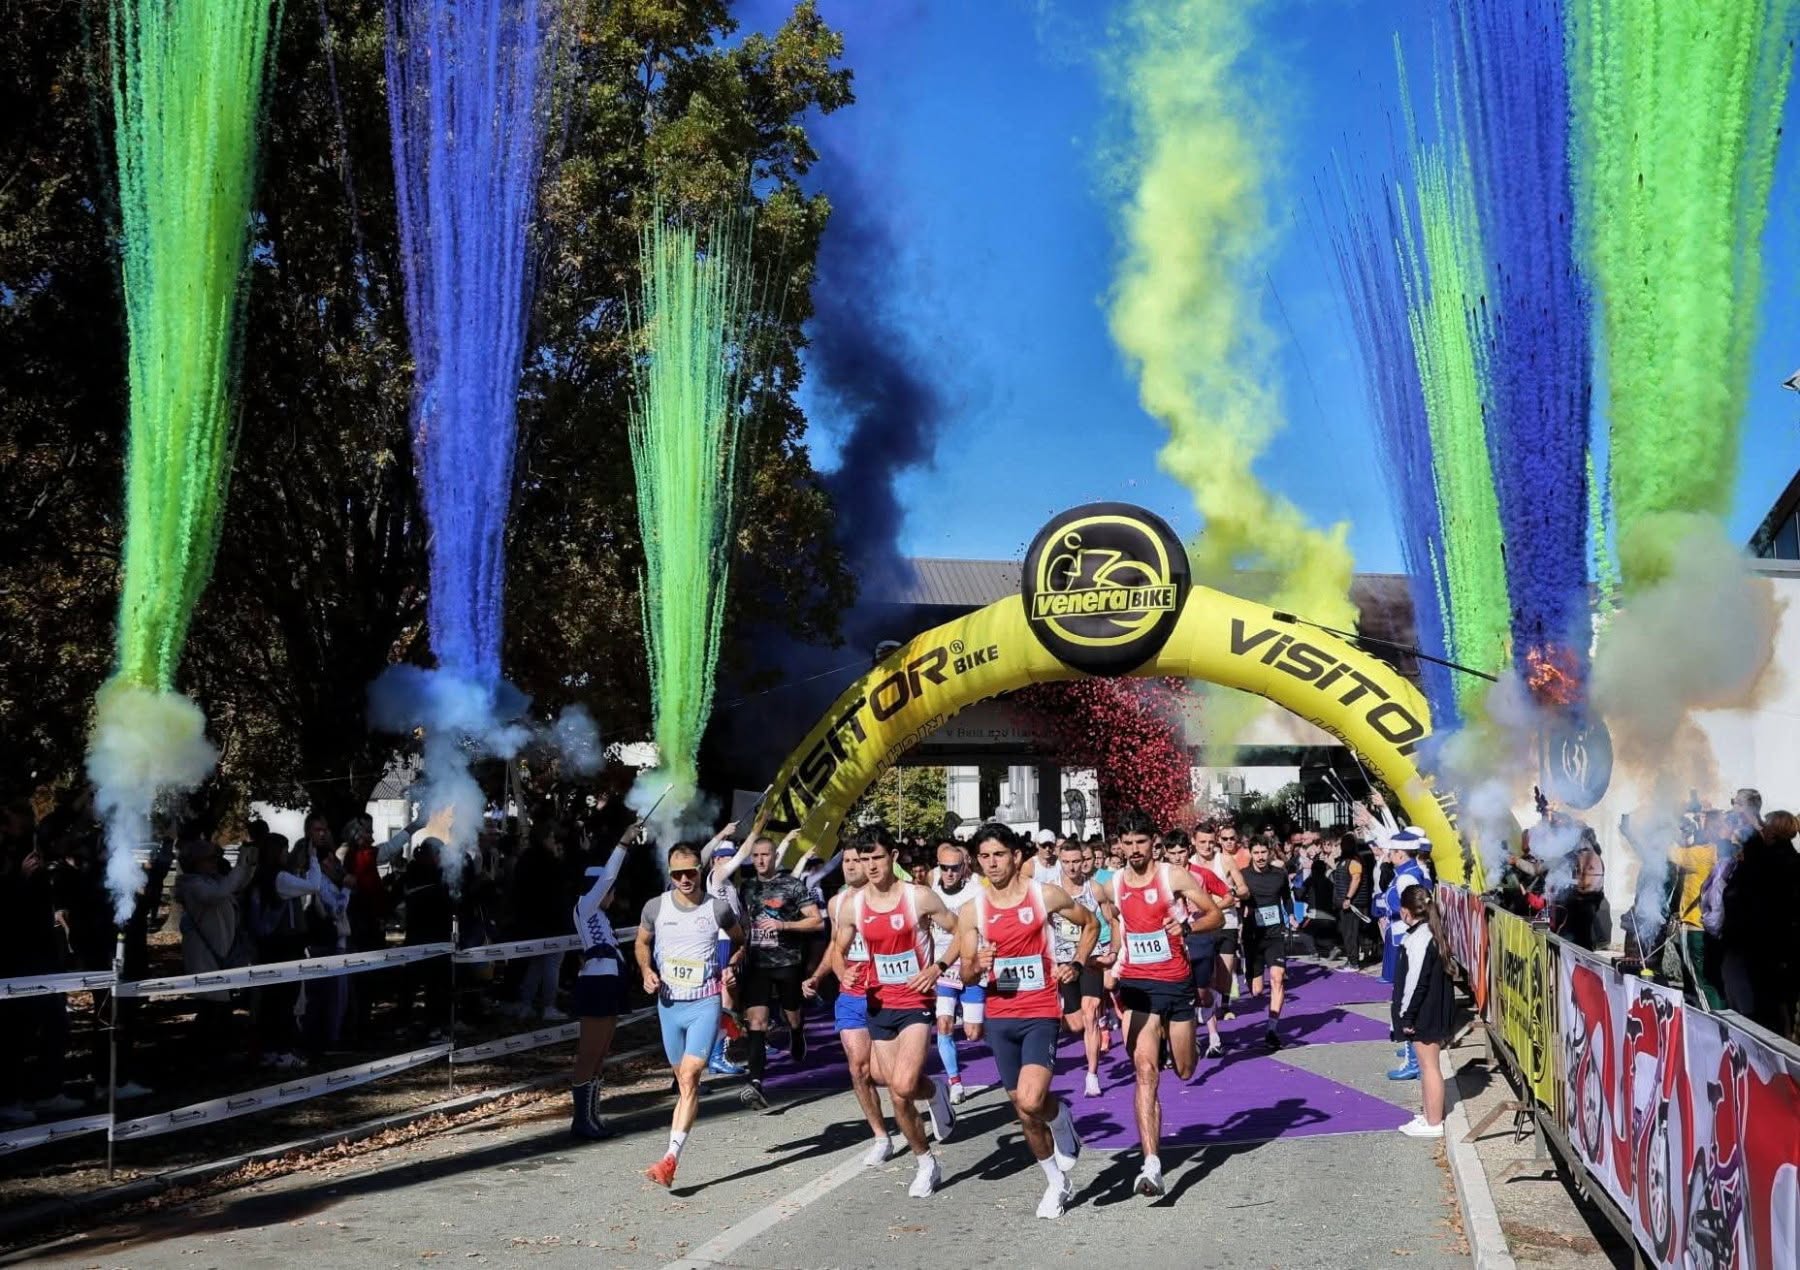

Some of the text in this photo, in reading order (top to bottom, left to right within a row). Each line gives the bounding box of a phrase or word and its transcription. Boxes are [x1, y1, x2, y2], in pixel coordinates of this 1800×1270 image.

[1036, 589, 1172, 616] venera BIKE
[952, 644, 999, 675] BIKE
[1134, 939, 1162, 953] 1118
[673, 966, 693, 979] 197
[882, 960, 910, 974] 1117
[1003, 965, 1036, 979] 1115
